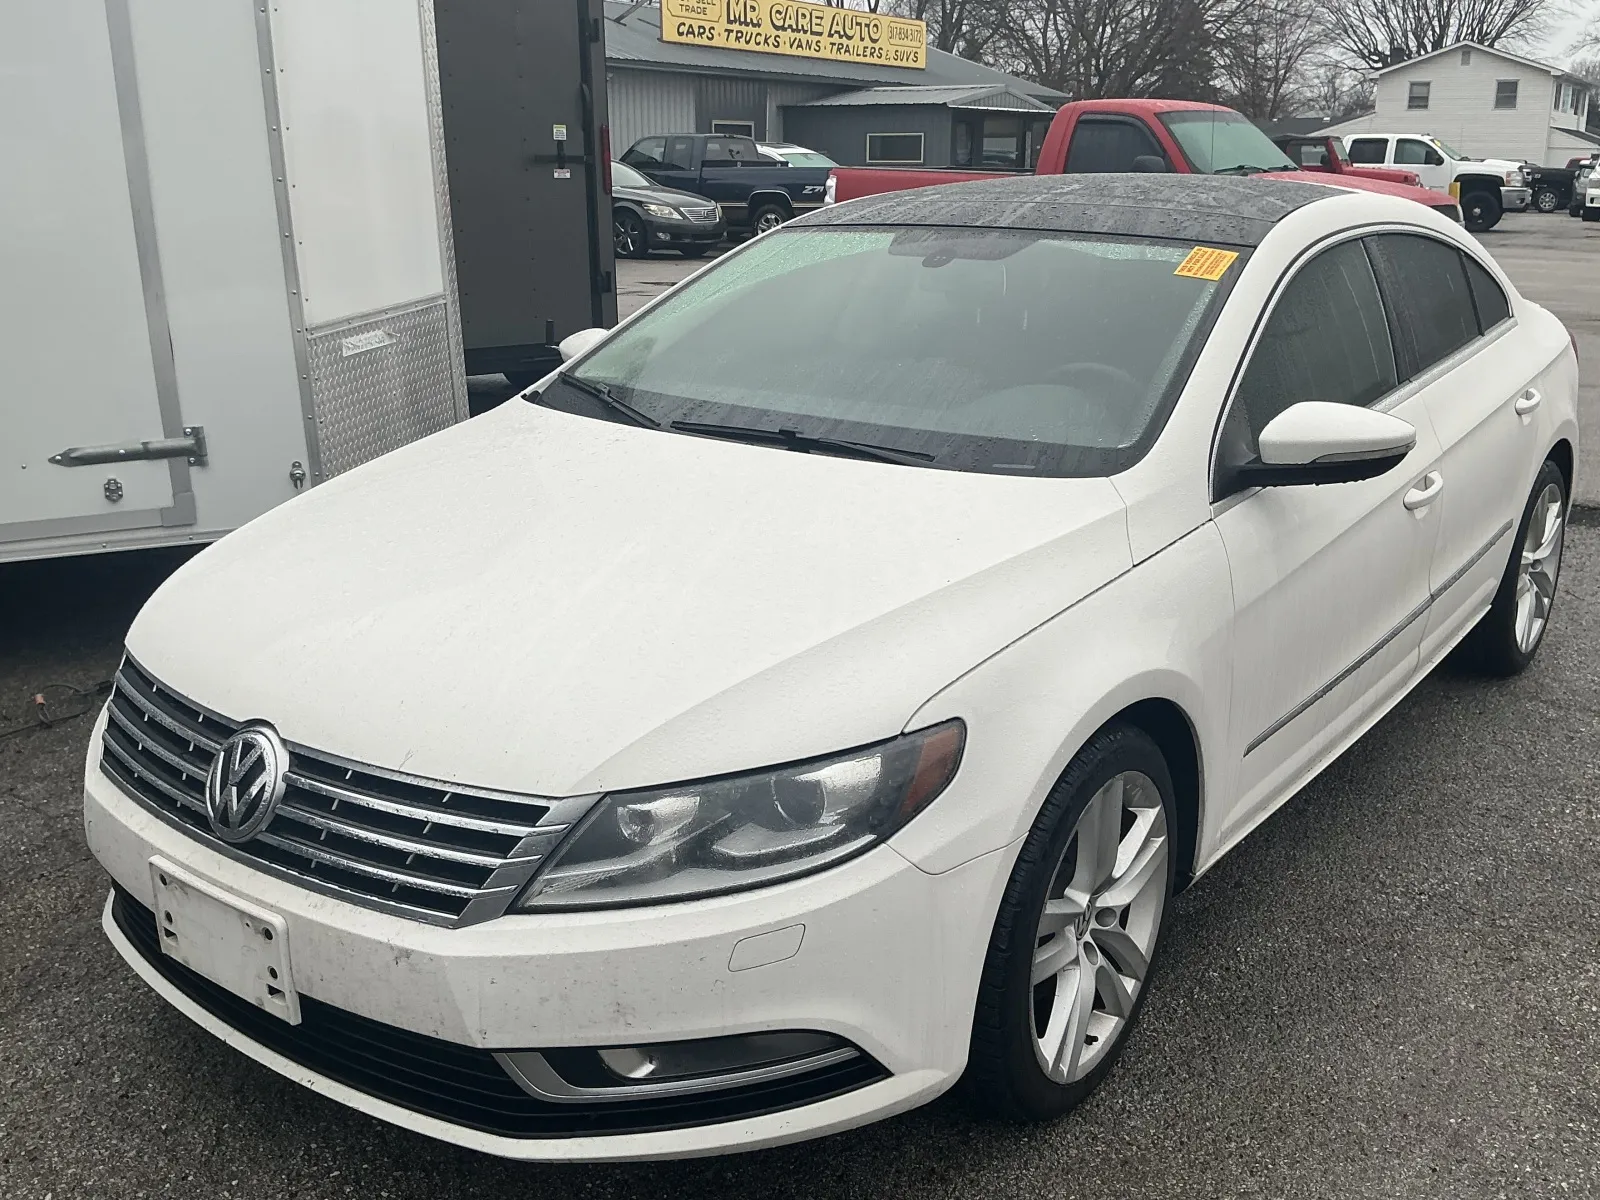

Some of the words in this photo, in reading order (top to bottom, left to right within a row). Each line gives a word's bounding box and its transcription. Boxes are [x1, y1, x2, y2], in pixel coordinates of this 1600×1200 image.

[679, 4, 708, 16] TRADE
[726, 0, 762, 28] MR.
[769, 3, 824, 36] CARE
[827, 12, 882, 44] AUTO
[676, 22, 715, 41] CARS
[724, 28, 780, 49] TRUCKS
[788, 36, 821, 53] VANS
[829, 42, 884, 59] TRAILERS
[893, 49, 919, 63] SUV'S
[889, 26, 922, 43] 317-834-3172
[802, 185, 825, 194] Z71
